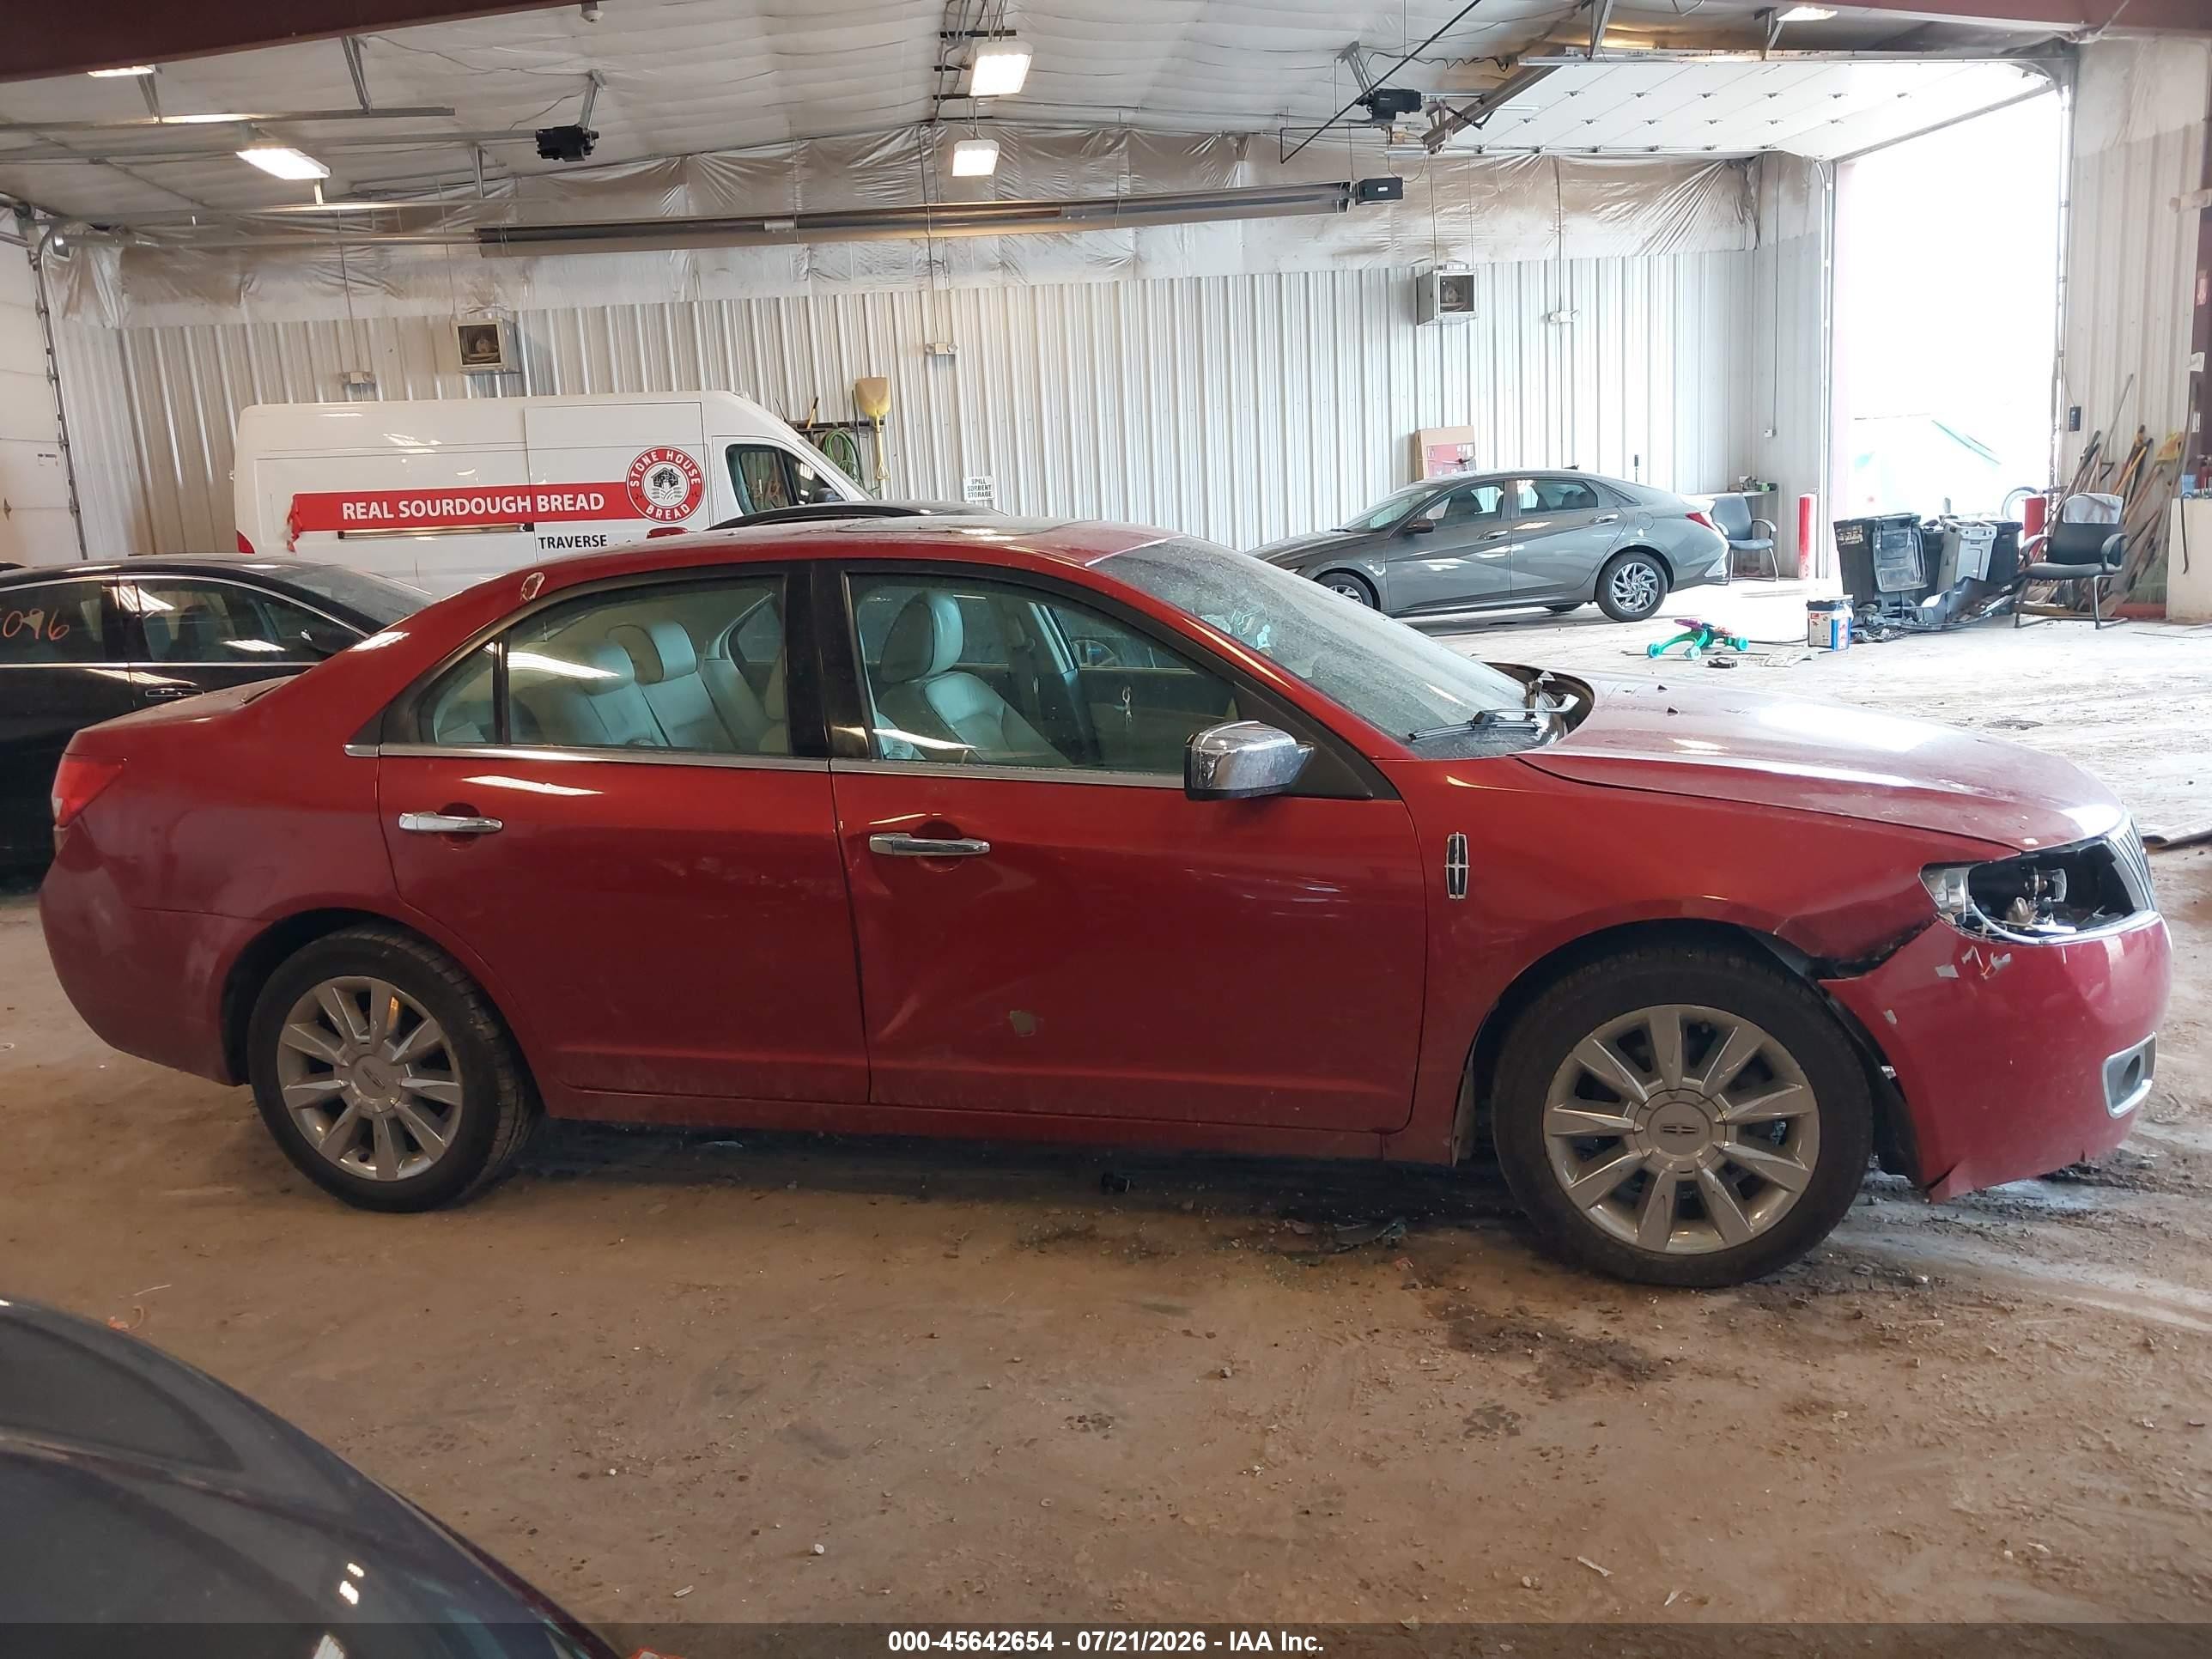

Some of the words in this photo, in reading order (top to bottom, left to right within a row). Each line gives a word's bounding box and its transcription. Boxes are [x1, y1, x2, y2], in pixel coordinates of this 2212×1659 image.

[629, 452, 659, 487] STONE
[666, 450, 701, 484] HOUSE
[342, 501, 394, 520] REAL
[398, 495, 532, 519] SOURDOUGH
[537, 493, 605, 513] BREAD
[646, 503, 690, 520] BREAD
[538, 534, 607, 550] TRAVERSE
